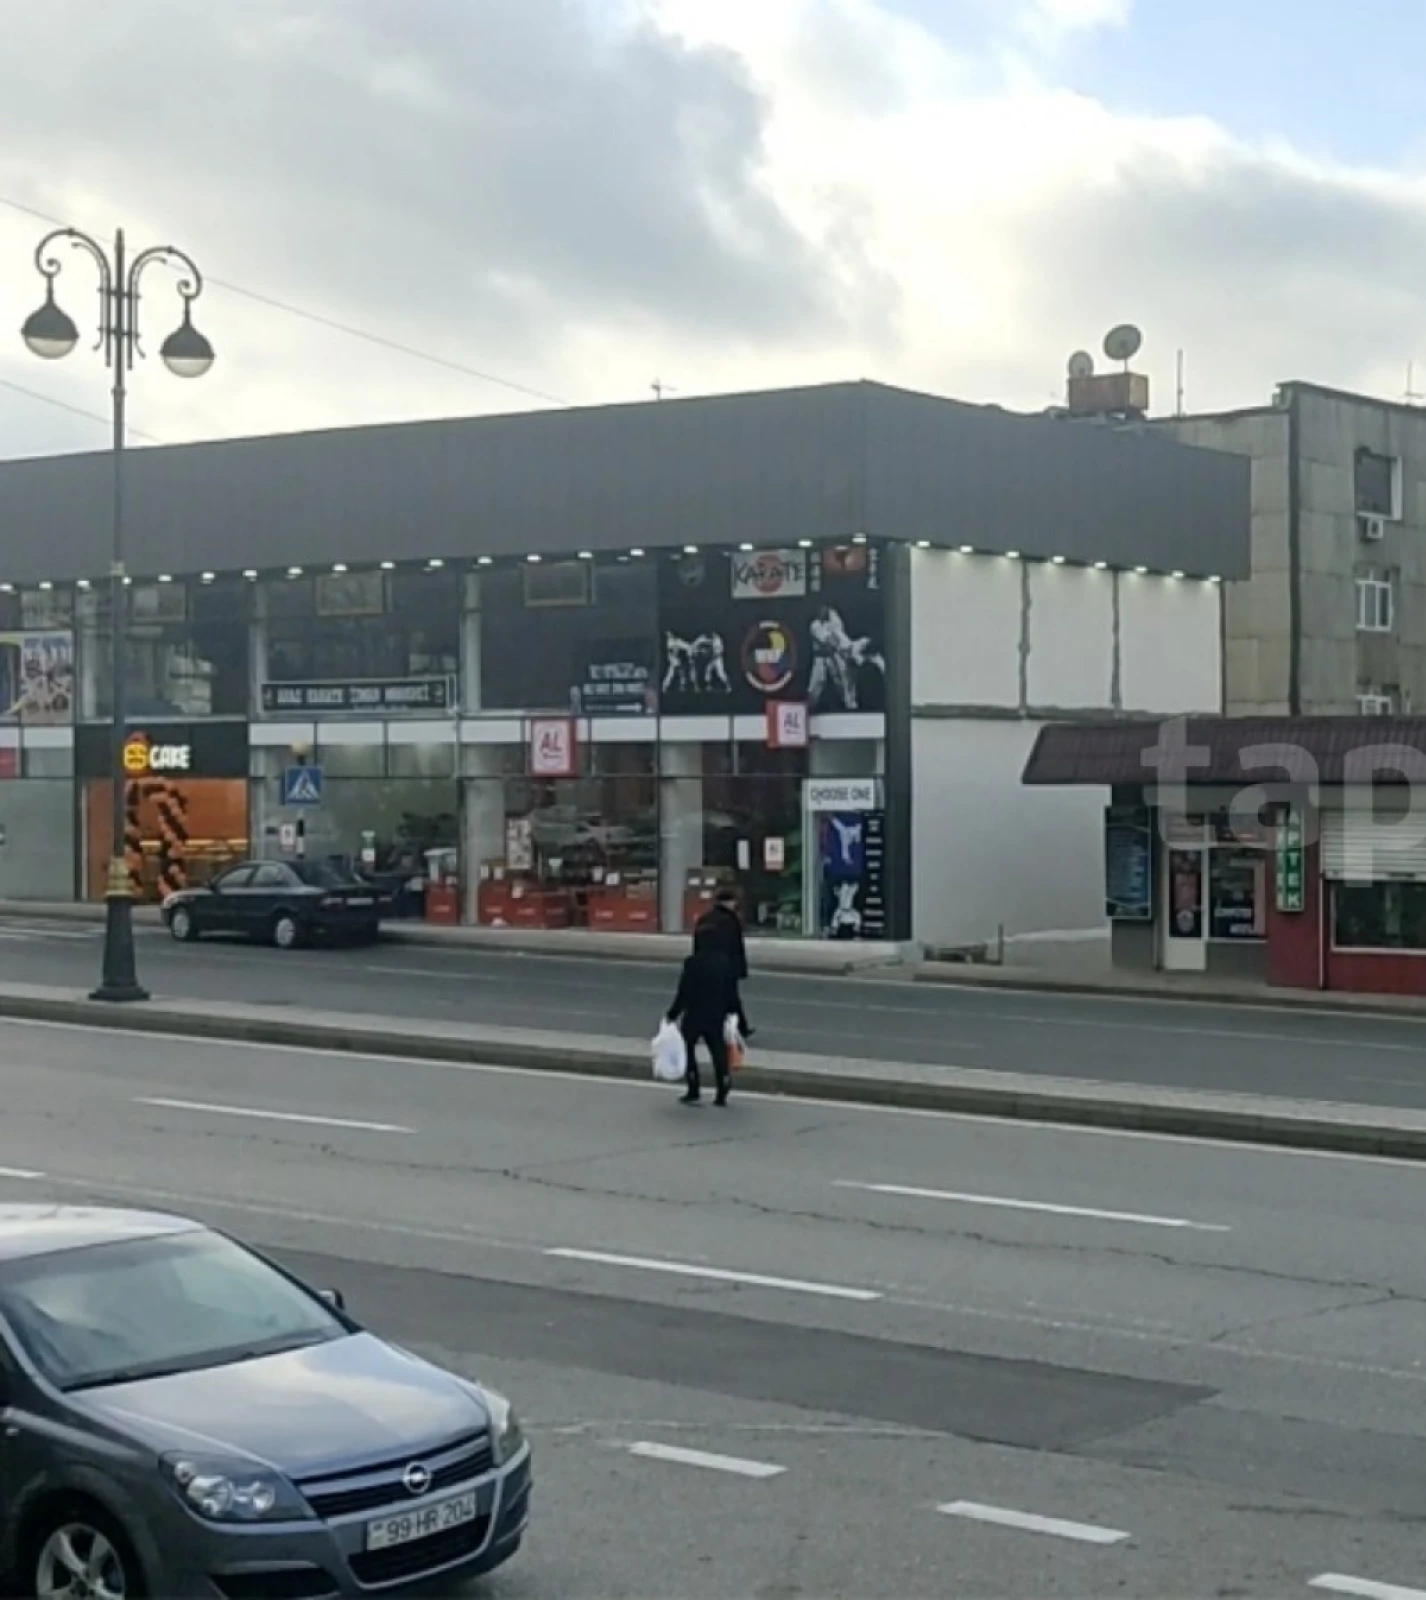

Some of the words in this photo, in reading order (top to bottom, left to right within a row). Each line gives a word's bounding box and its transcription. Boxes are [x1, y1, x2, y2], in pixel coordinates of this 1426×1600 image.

[735, 561, 805, 588] KARATE
[784, 712, 801, 729] AL
[540, 731, 563, 752] AL
[850, 784, 872, 801] ONE
